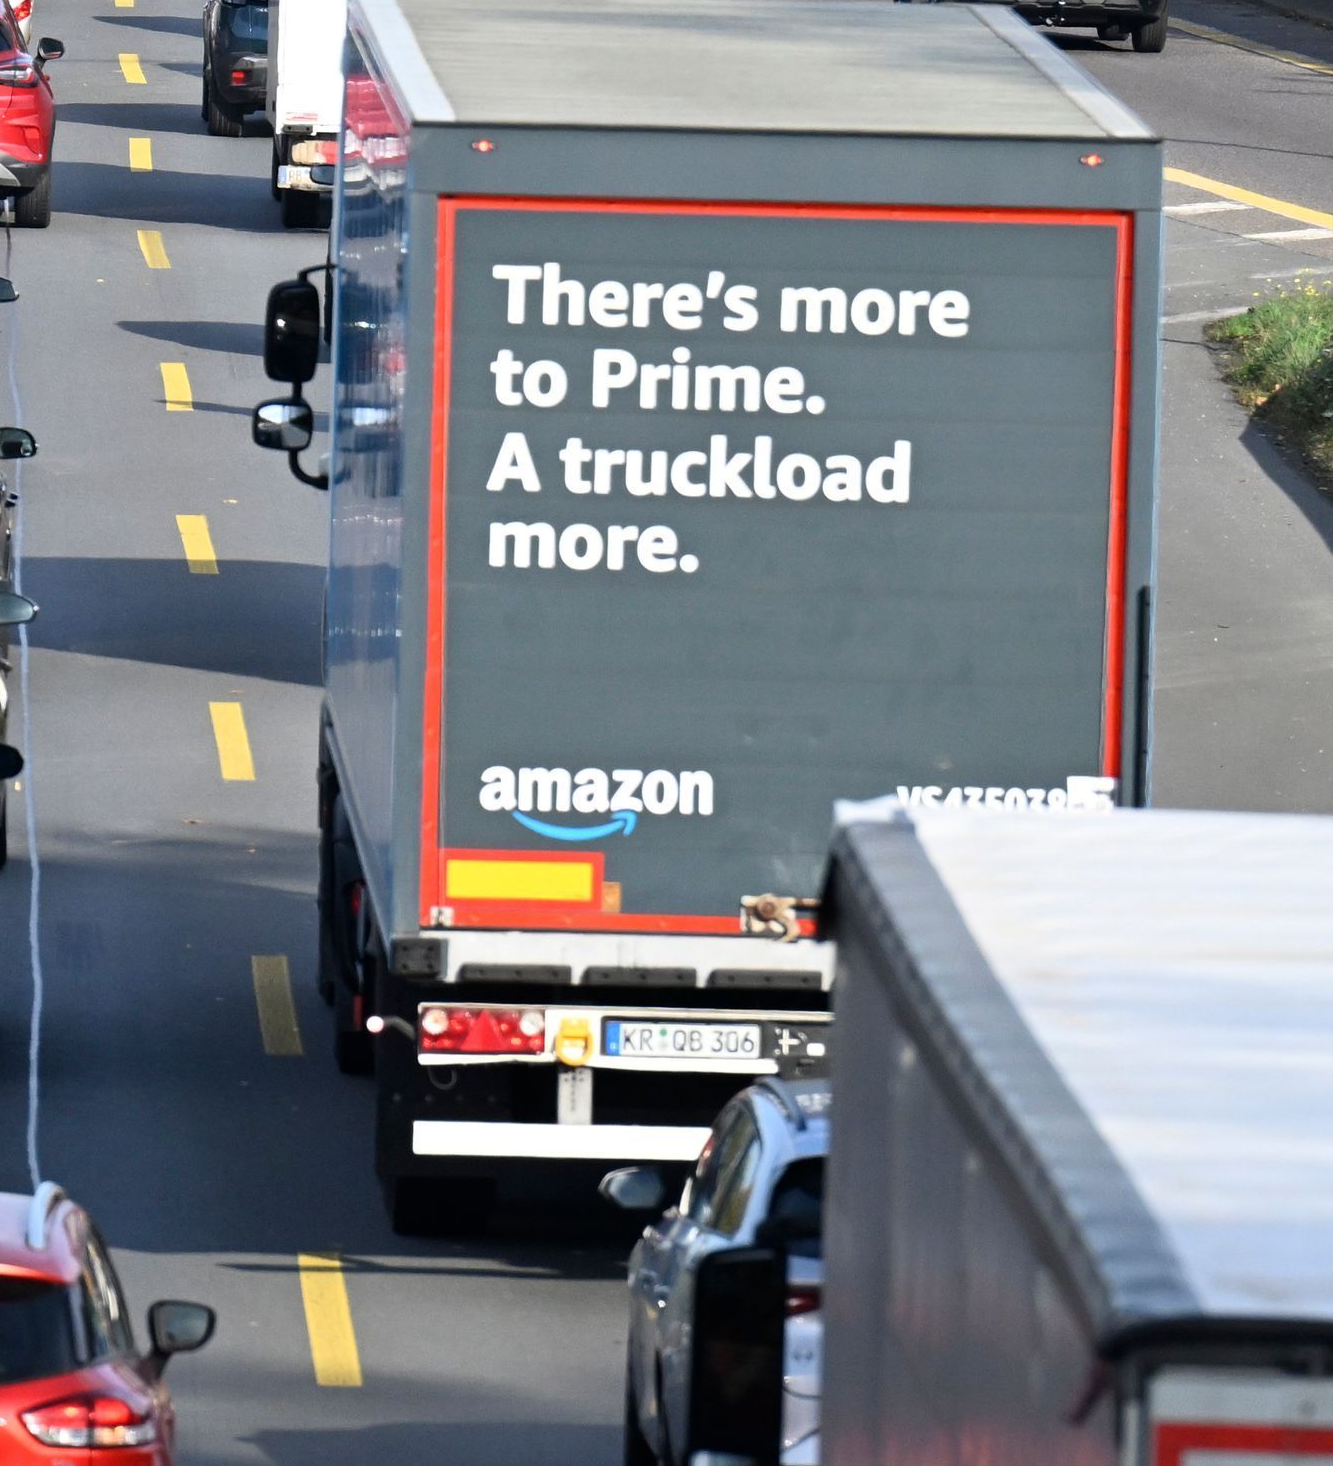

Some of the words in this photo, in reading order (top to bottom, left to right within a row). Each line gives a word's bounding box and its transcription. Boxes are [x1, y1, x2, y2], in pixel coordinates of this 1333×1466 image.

[490, 262, 759, 333] There's
[779, 287, 971, 339] more
[490, 347, 568, 408] to
[590, 347, 826, 415] Prime.
[486, 431, 541, 492] A
[559, 436, 912, 503] truckload
[487, 518, 700, 572] more.
[478, 765, 714, 815] amazon
[621, 1029, 653, 1052] KR
[672, 1030, 703, 1054] QB
[710, 1030, 755, 1054] 306
